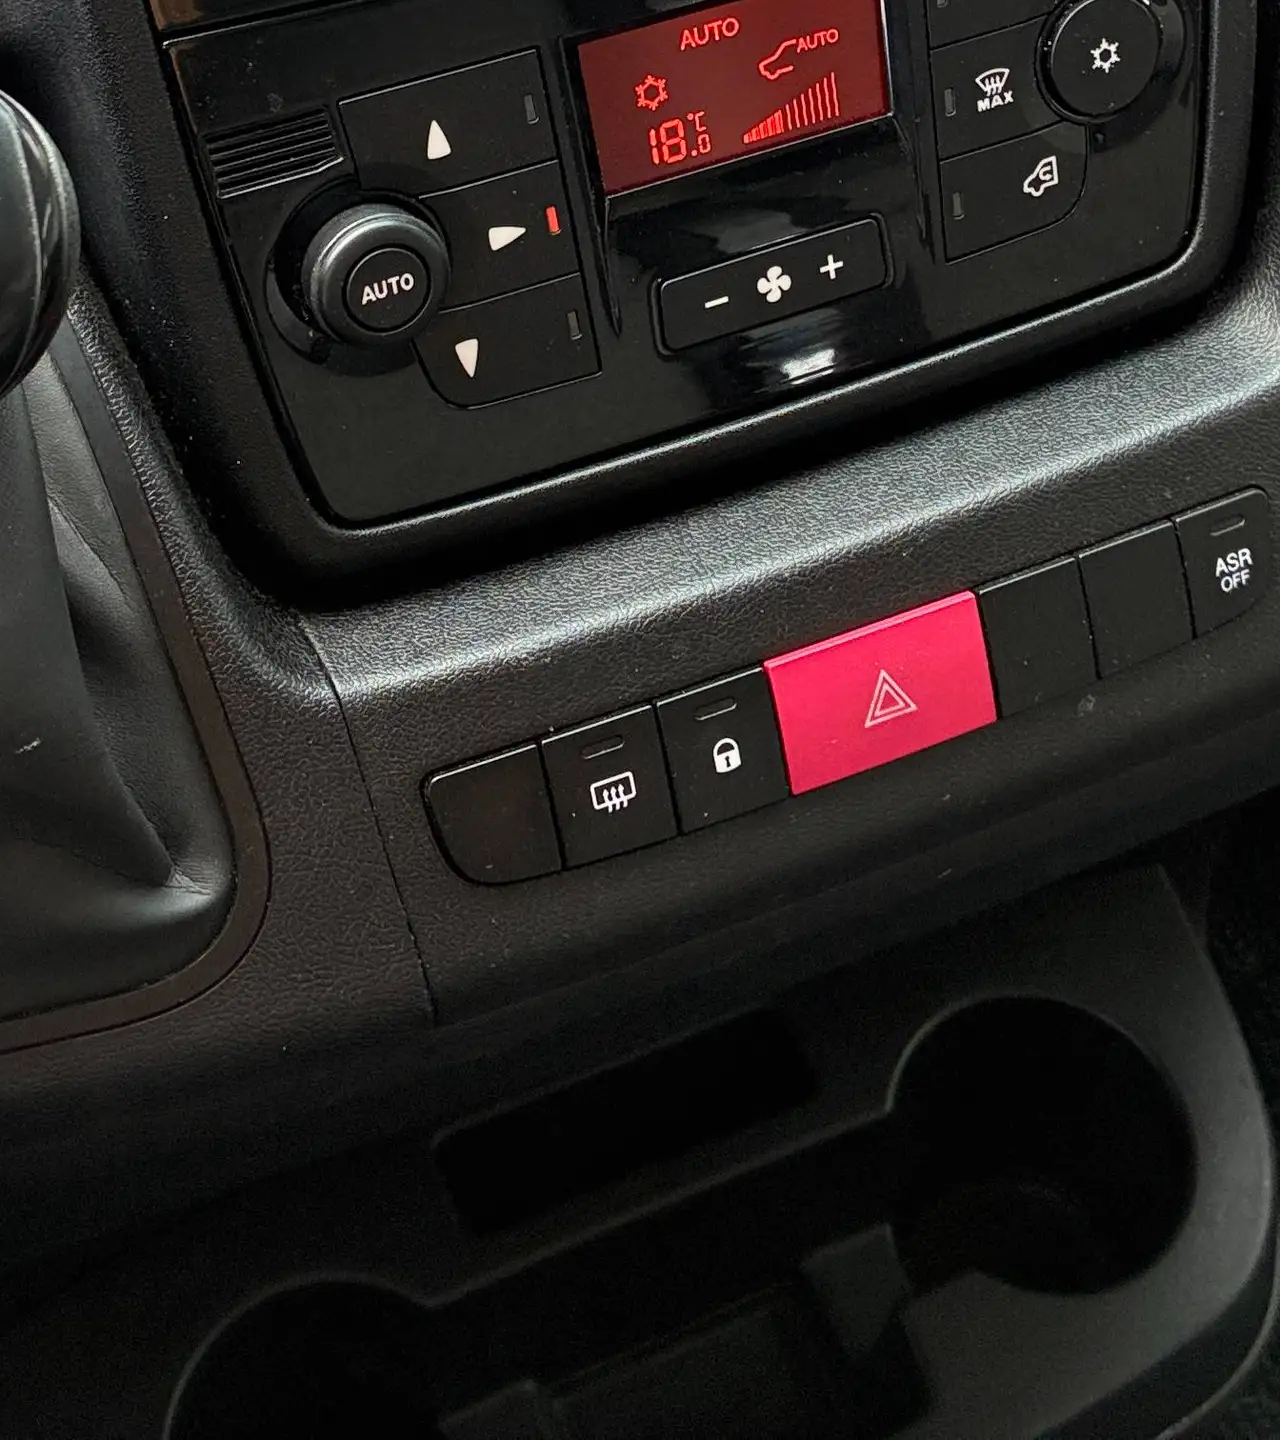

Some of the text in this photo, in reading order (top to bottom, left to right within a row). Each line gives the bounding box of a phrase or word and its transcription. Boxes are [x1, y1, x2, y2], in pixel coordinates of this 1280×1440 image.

[680, 17, 740, 51] AUTO
[796, 28, 839, 54] AUTO
[976, 90, 1014, 112] MAX
[361, 268, 415, 305] AUTO
[1215, 547, 1254, 578] ASR
[1220, 568, 1250, 593] OFF
